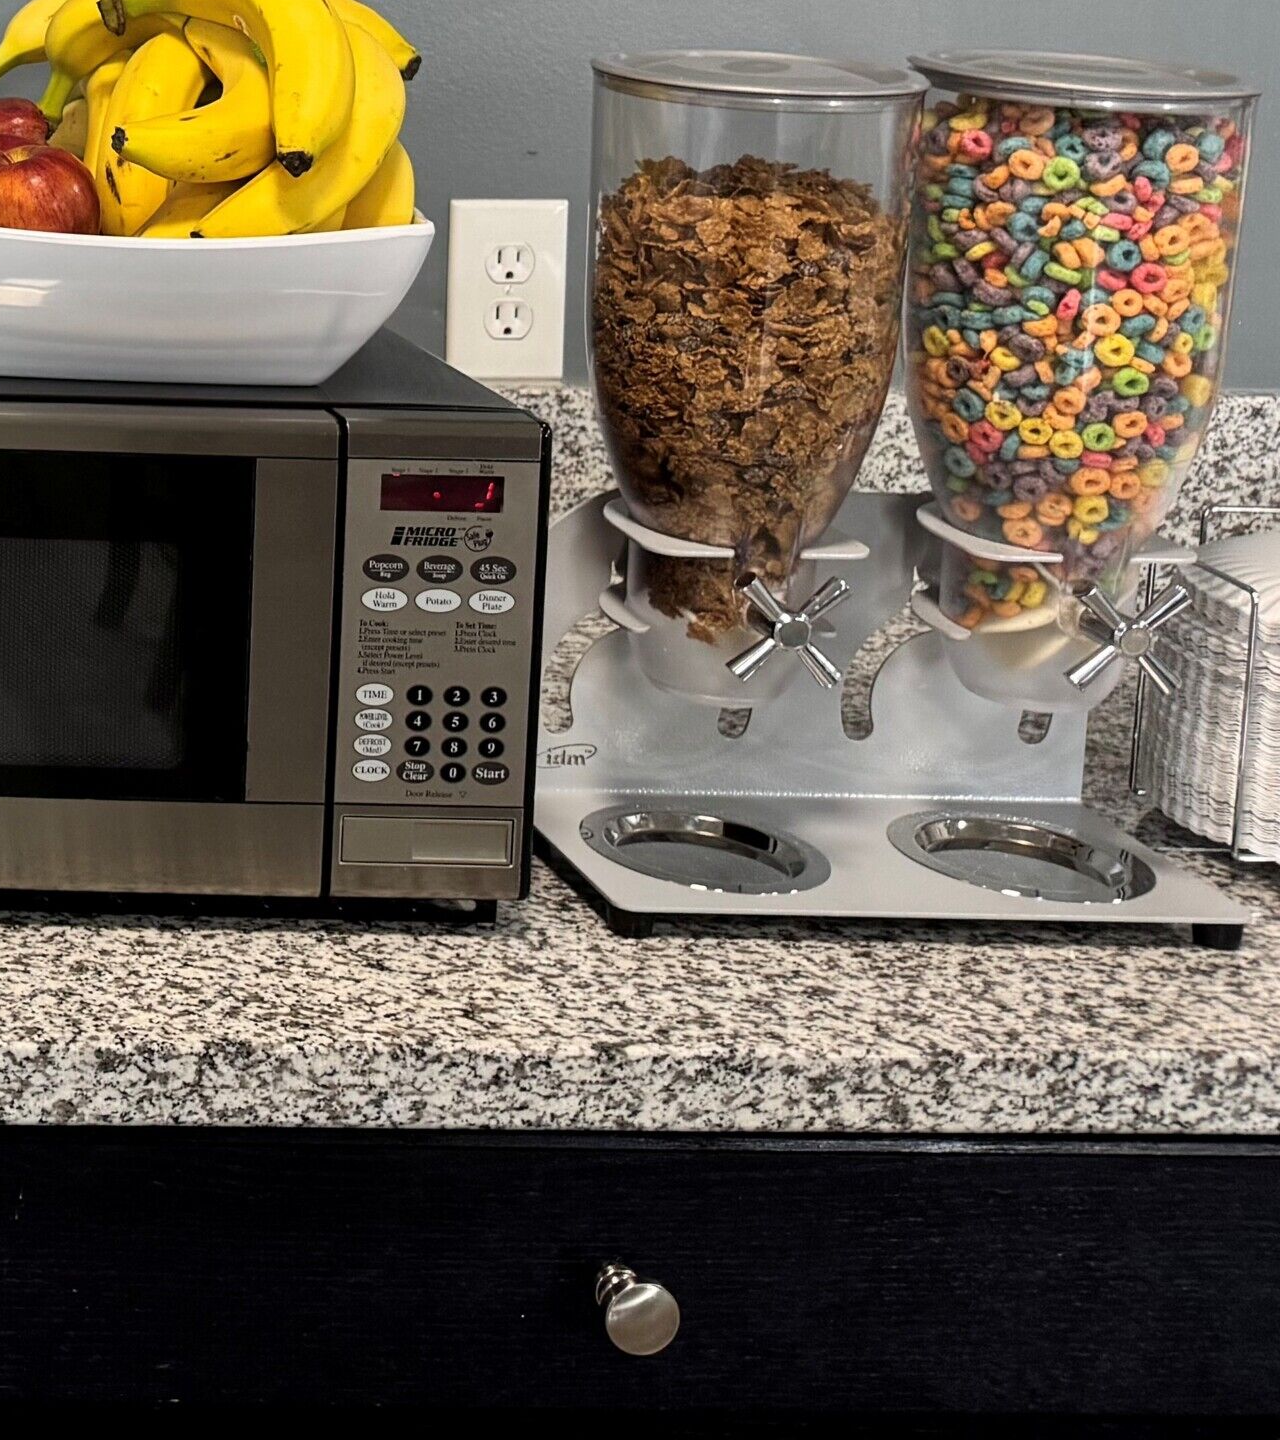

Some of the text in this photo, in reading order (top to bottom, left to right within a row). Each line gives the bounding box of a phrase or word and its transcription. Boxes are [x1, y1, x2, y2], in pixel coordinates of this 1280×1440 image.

[406, 527, 457, 537] MICRO
[403, 537, 459, 547] FRIDGE
[369, 560, 403, 571] Popcorn
[424, 561, 456, 572] Beverage
[479, 564, 490, 572] 45
[375, 591, 395, 600] Hold
[425, 597, 452, 605] Potato
[478, 593, 507, 602] Dinner
[373, 600, 397, 609] Warm
[482, 602, 503, 610] Plate
[362, 690, 387, 699] TIME
[417, 690, 422, 701] 1
[453, 690, 461, 702] 2
[490, 691, 498, 703] 3
[413, 715, 422, 726] 4
[451, 716, 460, 727] 5
[488, 717, 496, 728] 6
[358, 738, 386, 746] DEFROST
[413, 741, 421, 752] 7
[450, 742, 458, 753] 8
[487, 742, 495, 753] 9
[355, 766, 387, 774] CLOCK
[404, 760, 426, 771] Stop
[402, 771, 428, 781] Clear
[449, 767, 457, 778] 0
[475, 767, 505, 779] Start
[405, 789, 423, 797] Door
